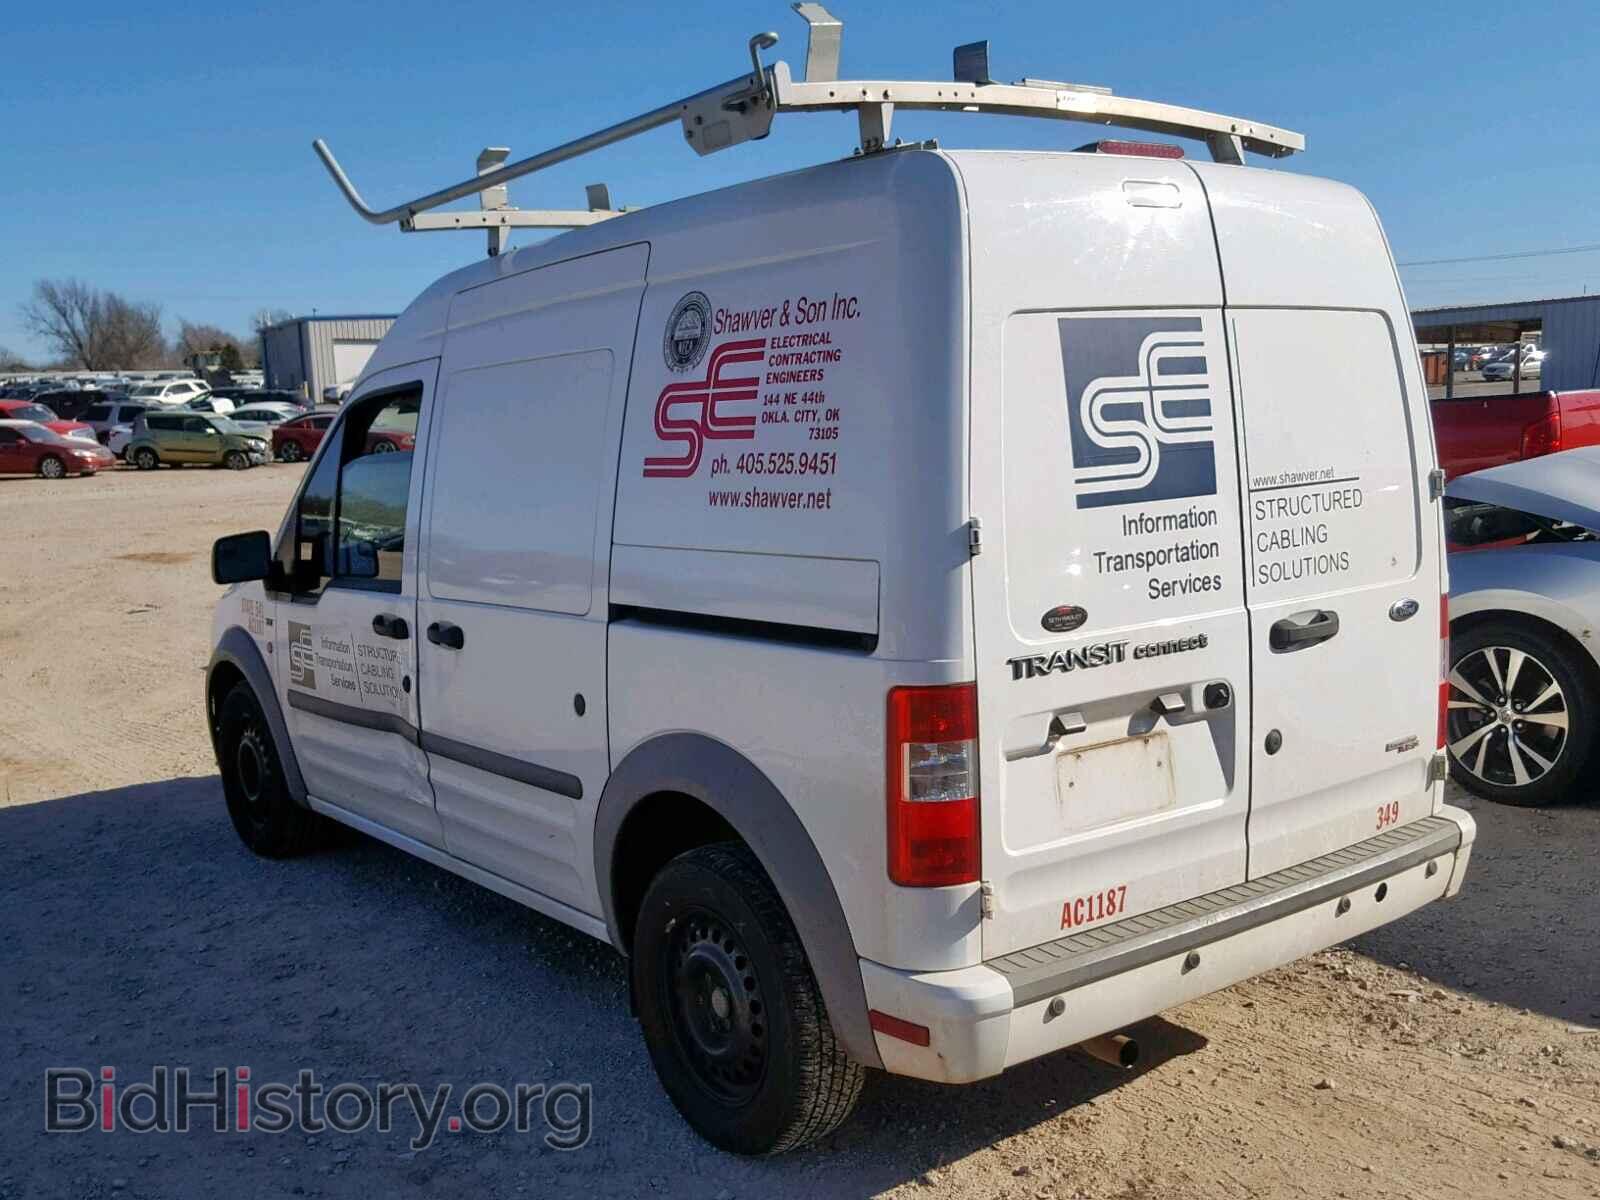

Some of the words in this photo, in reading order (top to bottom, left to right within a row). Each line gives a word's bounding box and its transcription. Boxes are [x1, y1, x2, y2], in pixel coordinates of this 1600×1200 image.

[713, 307, 776, 335] Shawver
[779, 299, 790, 327] &
[795, 296, 827, 325] Son
[831, 292, 861, 321] Inc.
[770, 331, 832, 349] ELECTRICAL
[768, 349, 841, 367] CONTRACTING
[766, 368, 824, 384] ENGINEERS
[763, 394, 780, 406] 144
[784, 392, 797, 405] NE
[801, 391, 825, 405] 44th
[761, 409, 790, 423] OKLA.
[794, 408, 821, 423] CITY,
[825, 408, 840, 422] OK
[808, 427, 839, 440] 73105
[711, 453, 731, 478] ph.
[736, 451, 837, 476] 405.525.9451
[1253, 466, 1335, 487] www.shawver.net
[709, 486, 832, 509] www.shawver.net
[1255, 488, 1362, 521] STRUCTURED
[1122, 505, 1217, 536] Information
[1257, 523, 1328, 552] CABLING
[1094, 539, 1219, 574] Transportation
[1258, 551, 1350, 584] SOLUTIONS
[1148, 573, 1222, 600] Services
[1006, 639, 1129, 680] TRANSIT
[1133, 632, 1209, 660] connect
[1376, 800, 1399, 830] 349
[1060, 885, 1127, 930] AC1187
